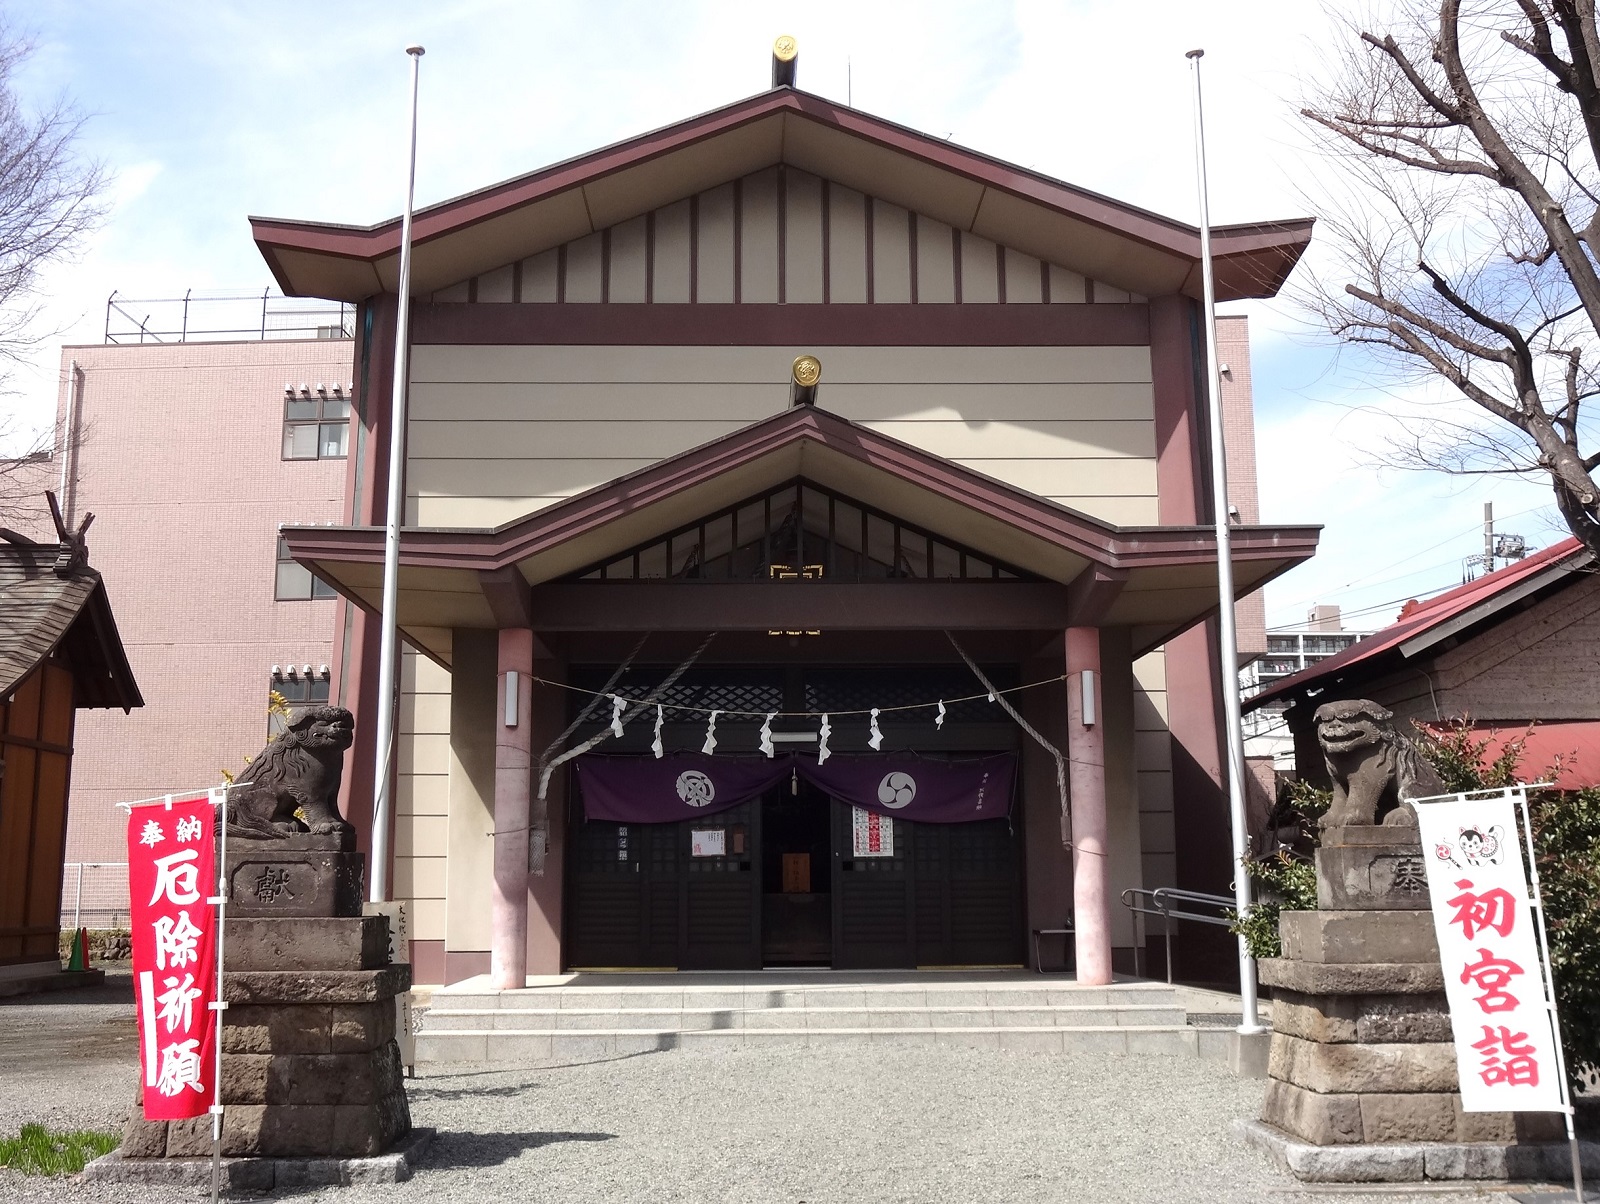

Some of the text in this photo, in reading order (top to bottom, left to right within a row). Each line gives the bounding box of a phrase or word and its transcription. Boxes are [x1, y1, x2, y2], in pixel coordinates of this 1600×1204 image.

[139, 814, 203, 849] 奉納
[148, 847, 205, 1097] 厄除祈願
[1447, 878, 1539, 1087] 初宮詣
